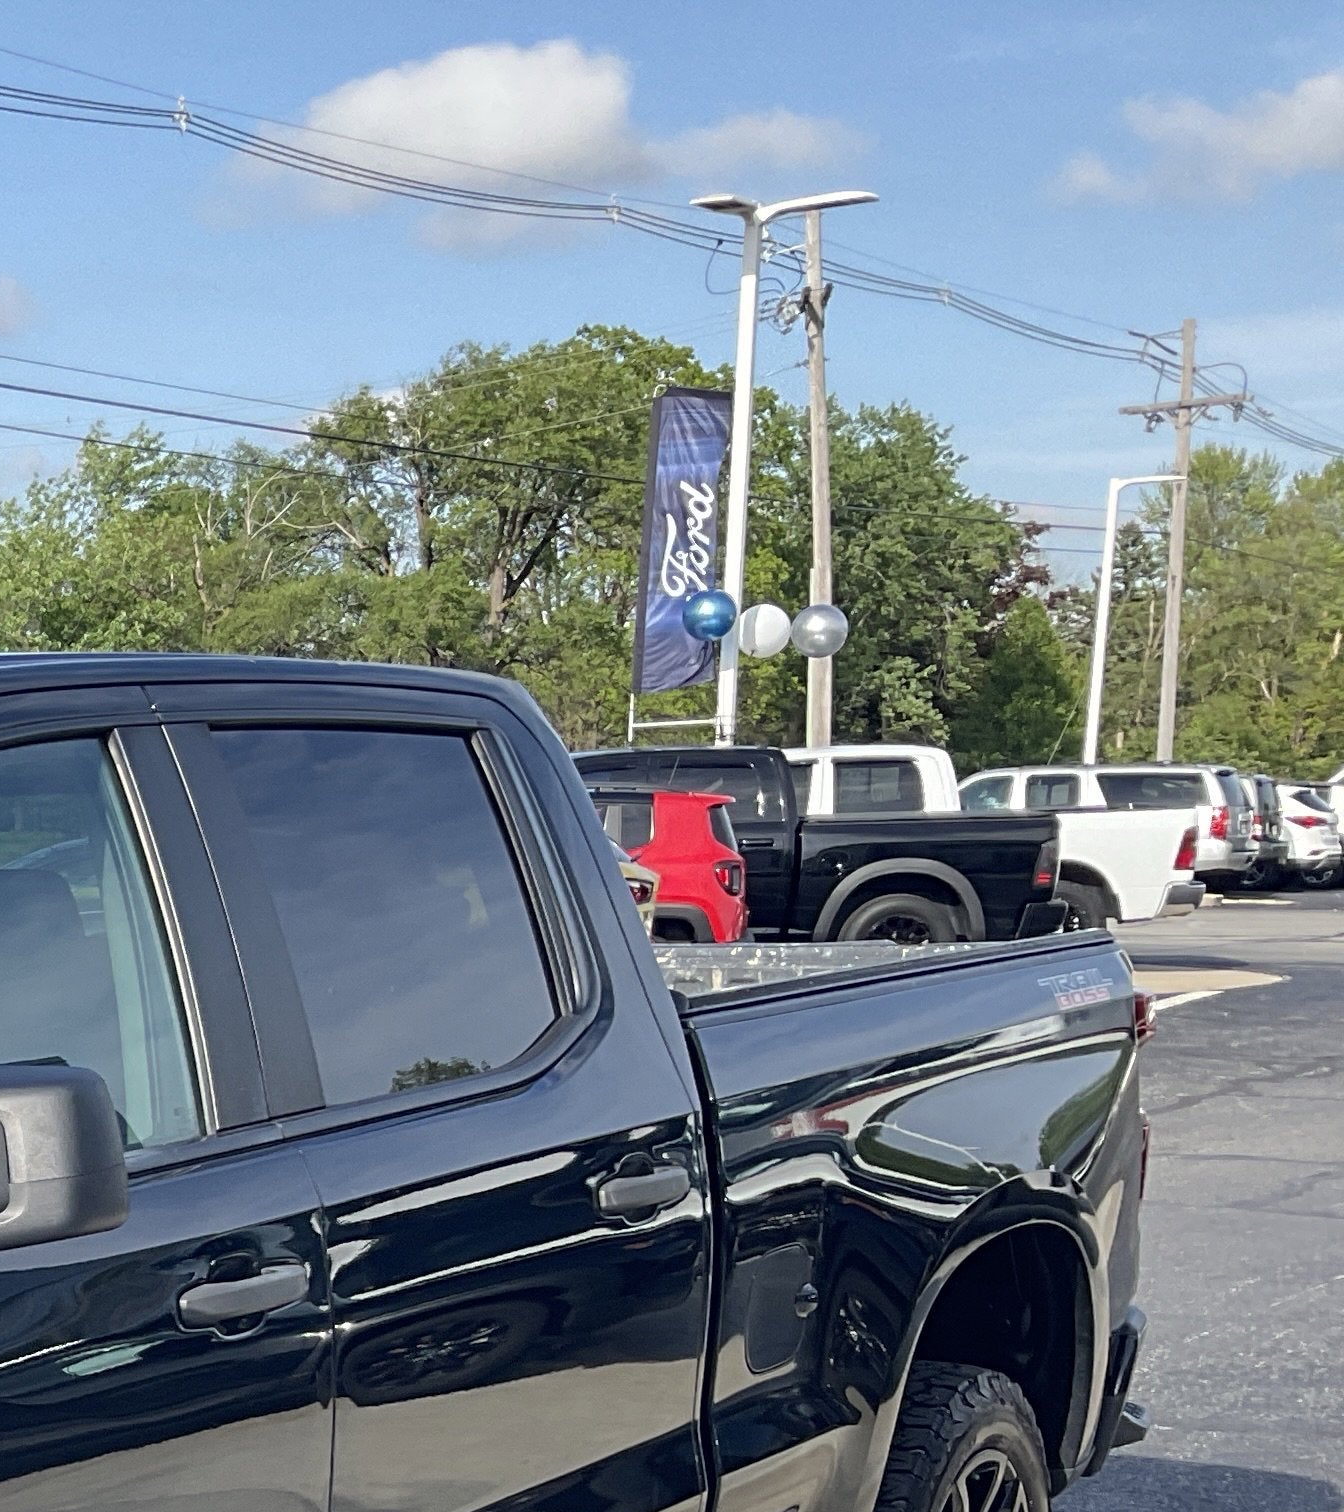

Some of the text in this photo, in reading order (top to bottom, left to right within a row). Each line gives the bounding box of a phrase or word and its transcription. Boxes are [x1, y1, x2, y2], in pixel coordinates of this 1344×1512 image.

[661, 480, 715, 601] Ford
[1037, 967, 1113, 995] TRAIL
[1054, 986, 1111, 1011] BOSS
